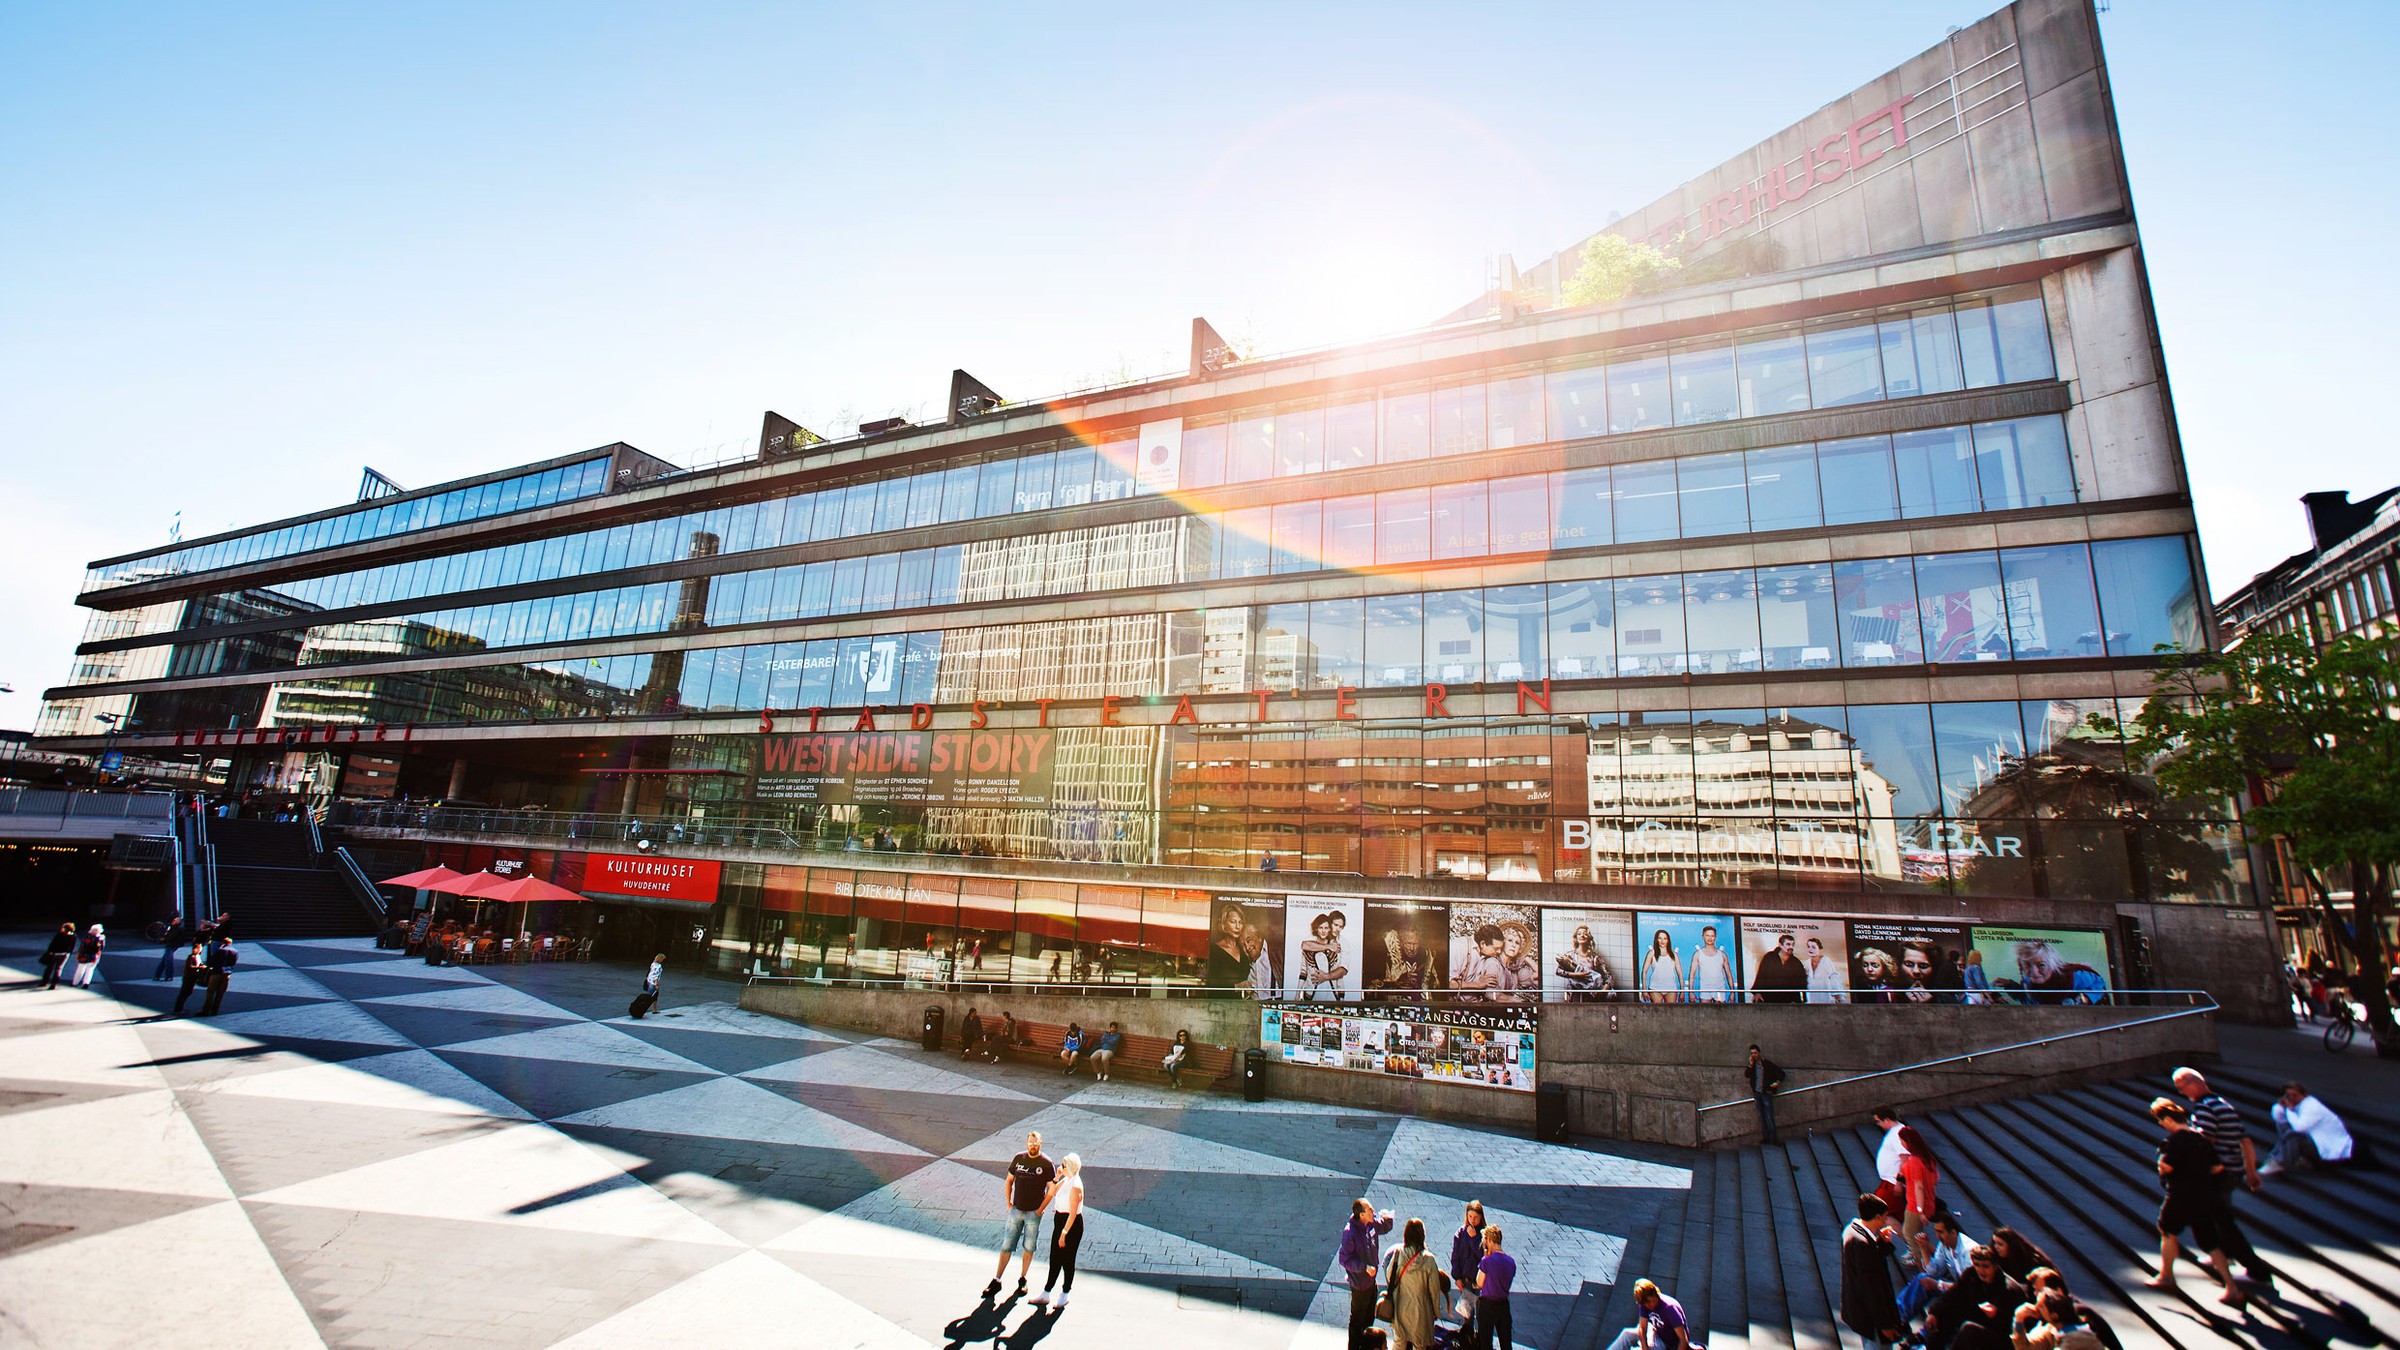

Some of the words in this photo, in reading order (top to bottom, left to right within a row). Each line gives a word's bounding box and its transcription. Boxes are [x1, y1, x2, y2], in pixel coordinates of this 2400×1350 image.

[765, 655, 840, 672] TEATERBAREN
[899, 651, 922, 663] café
[762, 734, 845, 774] WEST
[847, 734, 921, 772] SIDE
[929, 734, 1050, 773] STORY
[607, 860, 695, 878] KULTURHUSET
[623, 880, 671, 892] HUVUDENTRÉ
[1424, 1012, 1532, 1031] ANSLAGSTAVLA
